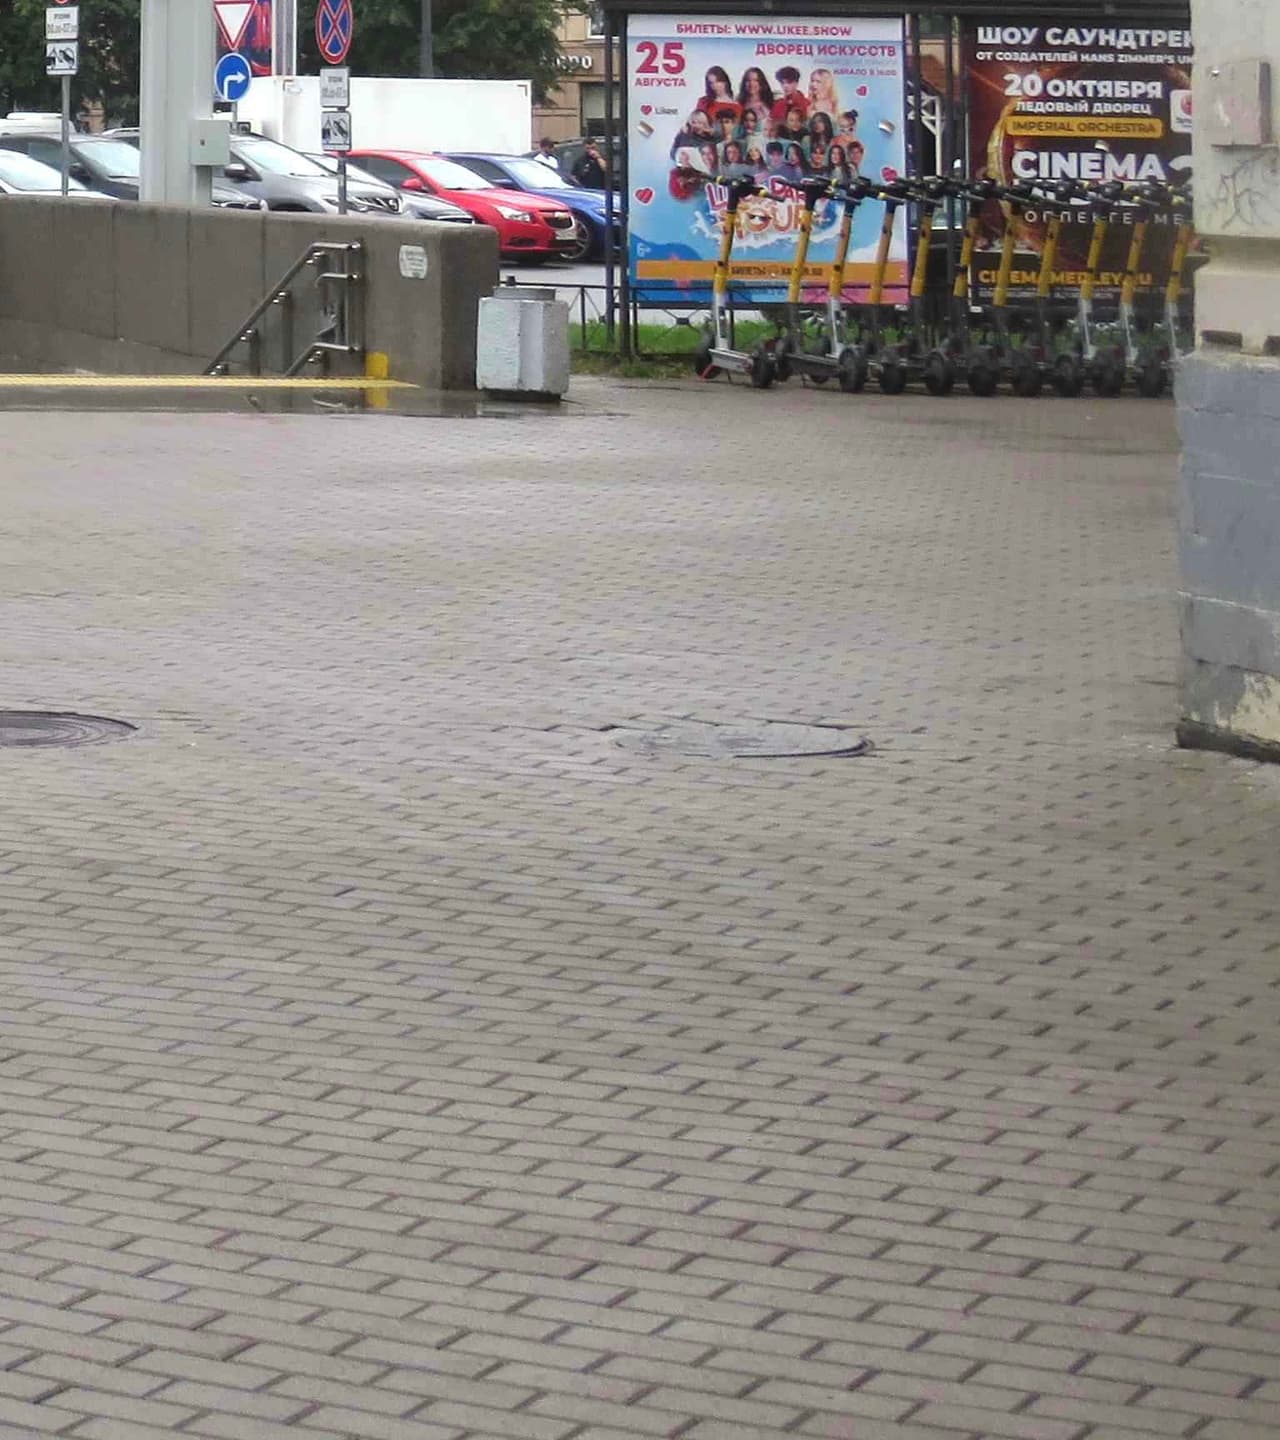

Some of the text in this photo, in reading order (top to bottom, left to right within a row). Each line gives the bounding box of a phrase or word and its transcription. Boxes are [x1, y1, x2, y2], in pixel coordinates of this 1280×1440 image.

[676, 23, 853, 37] БИЛЕТЫ: WWW.LIKEE.SHOW
[976, 26, 1039, 46] ШОУ
[634, 40, 686, 75] 25
[755, 43, 897, 58] ДВОРЕЦ ИСКУССТВ
[975, 51, 993, 61] ОТ
[995, 50, 1078, 63] СОЗДАТЕЛЕЙ
[1080, 53, 1115, 63] HANS
[634, 77, 687, 88] АВГУСТА
[1003, 73, 1163, 99] 20 ОКТЯБРЯ
[1014, 100, 1152, 116] ЛЕДОВЫЙ ДВОРЕЦ
[1012, 120, 1156, 134] IMPERIAL ORCHESTRA
[1011, 150, 1167, 180] CINEMA
